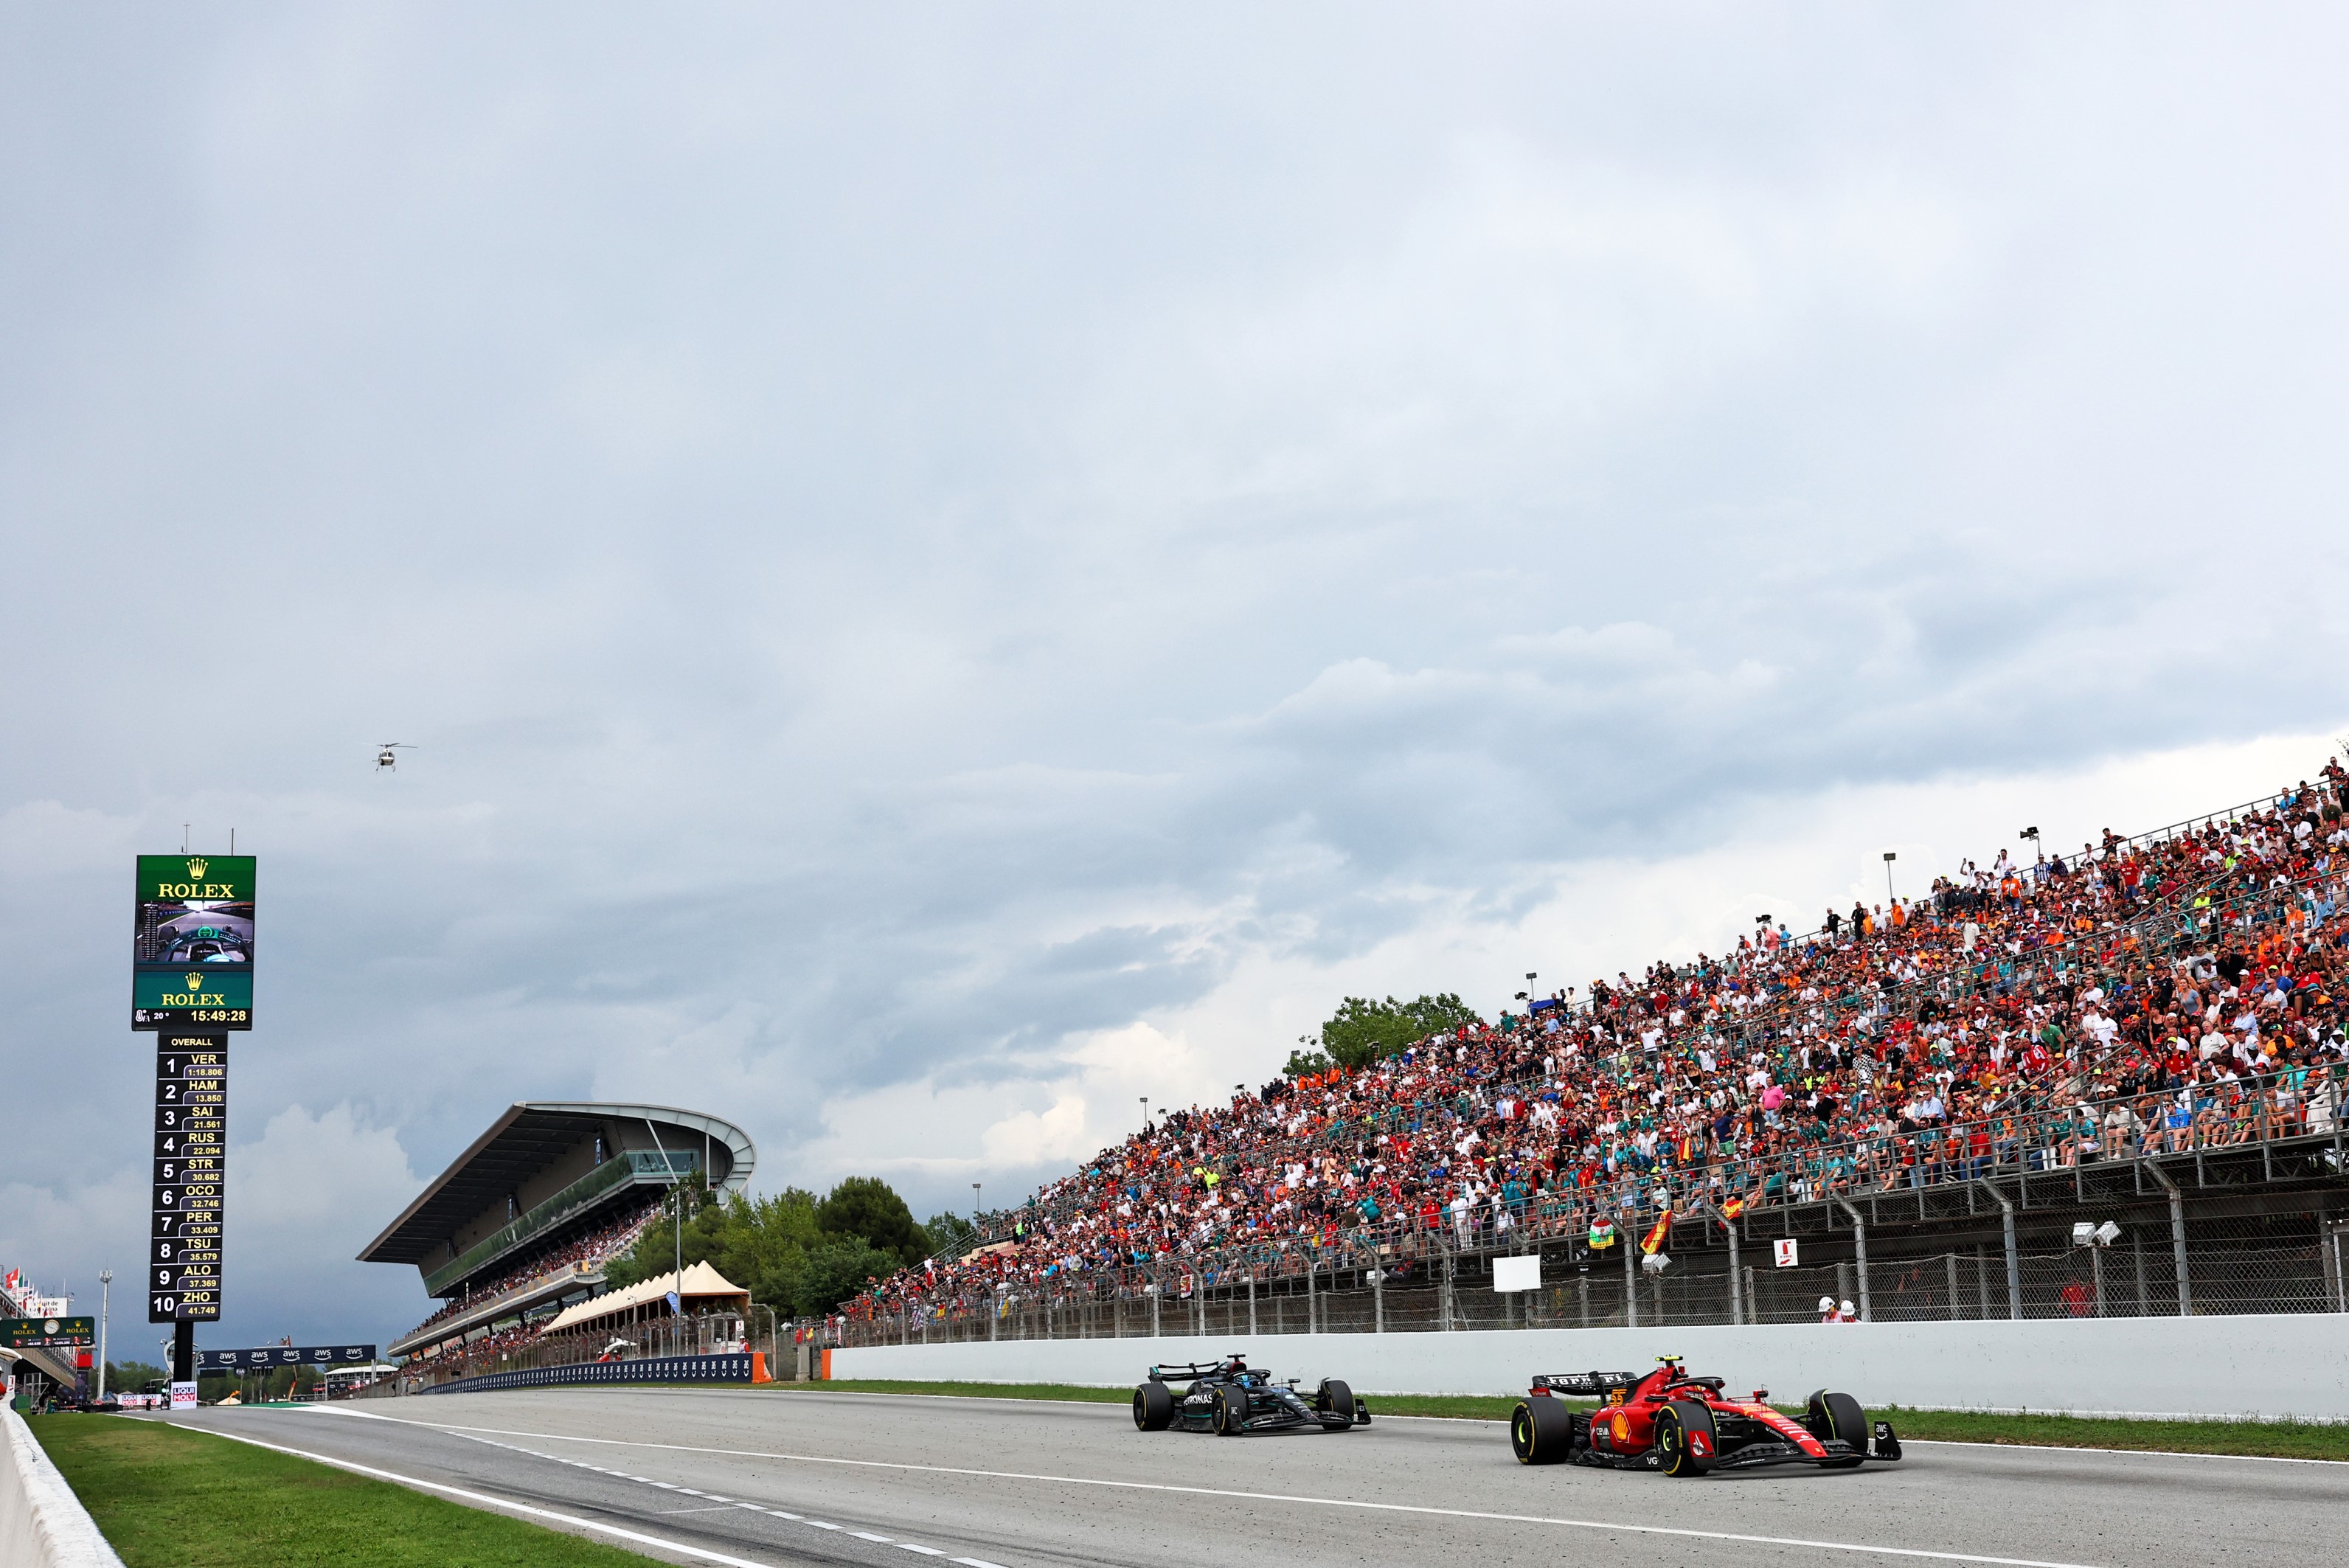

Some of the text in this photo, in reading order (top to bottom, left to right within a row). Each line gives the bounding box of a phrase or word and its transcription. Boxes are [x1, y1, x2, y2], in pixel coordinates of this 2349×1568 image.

[2146, 839, 2152, 848] 11
[158, 884, 235, 898] ROLEX
[162, 994, 225, 1006] ROLEX
[191, 1010, 246, 1021] 15:49:28
[167, 1058, 174, 1072] 1
[191, 1055, 217, 1064] VER
[189, 1081, 217, 1090] HAM
[165, 1085, 176, 1099] 2
[192, 1107, 213, 1116] SAI
[165, 1111, 175, 1125] 3
[188, 1133, 214, 1142] RUS
[163, 1137, 175, 1151] 4
[188, 1159, 213, 1169] STR
[163, 1164, 173, 1178] 5
[186, 1185, 214, 1196] OCO
[162, 1190, 173, 1205] 6
[186, 1212, 212, 1222] PER
[162, 1217, 172, 1231] 7
[186, 1239, 210, 1248] TSU
[160, 1244, 171, 1258] 8
[184, 1265, 211, 1275] ALO
[159, 1270, 170, 1285] 9
[183, 1292, 210, 1302] ZHO
[154, 1297, 174, 1312] 10
[1547, 1374, 1624, 1385] Ferrri
[1609, 1389, 1627, 1406] 55
[1876, 1424, 1887, 1432] aws
